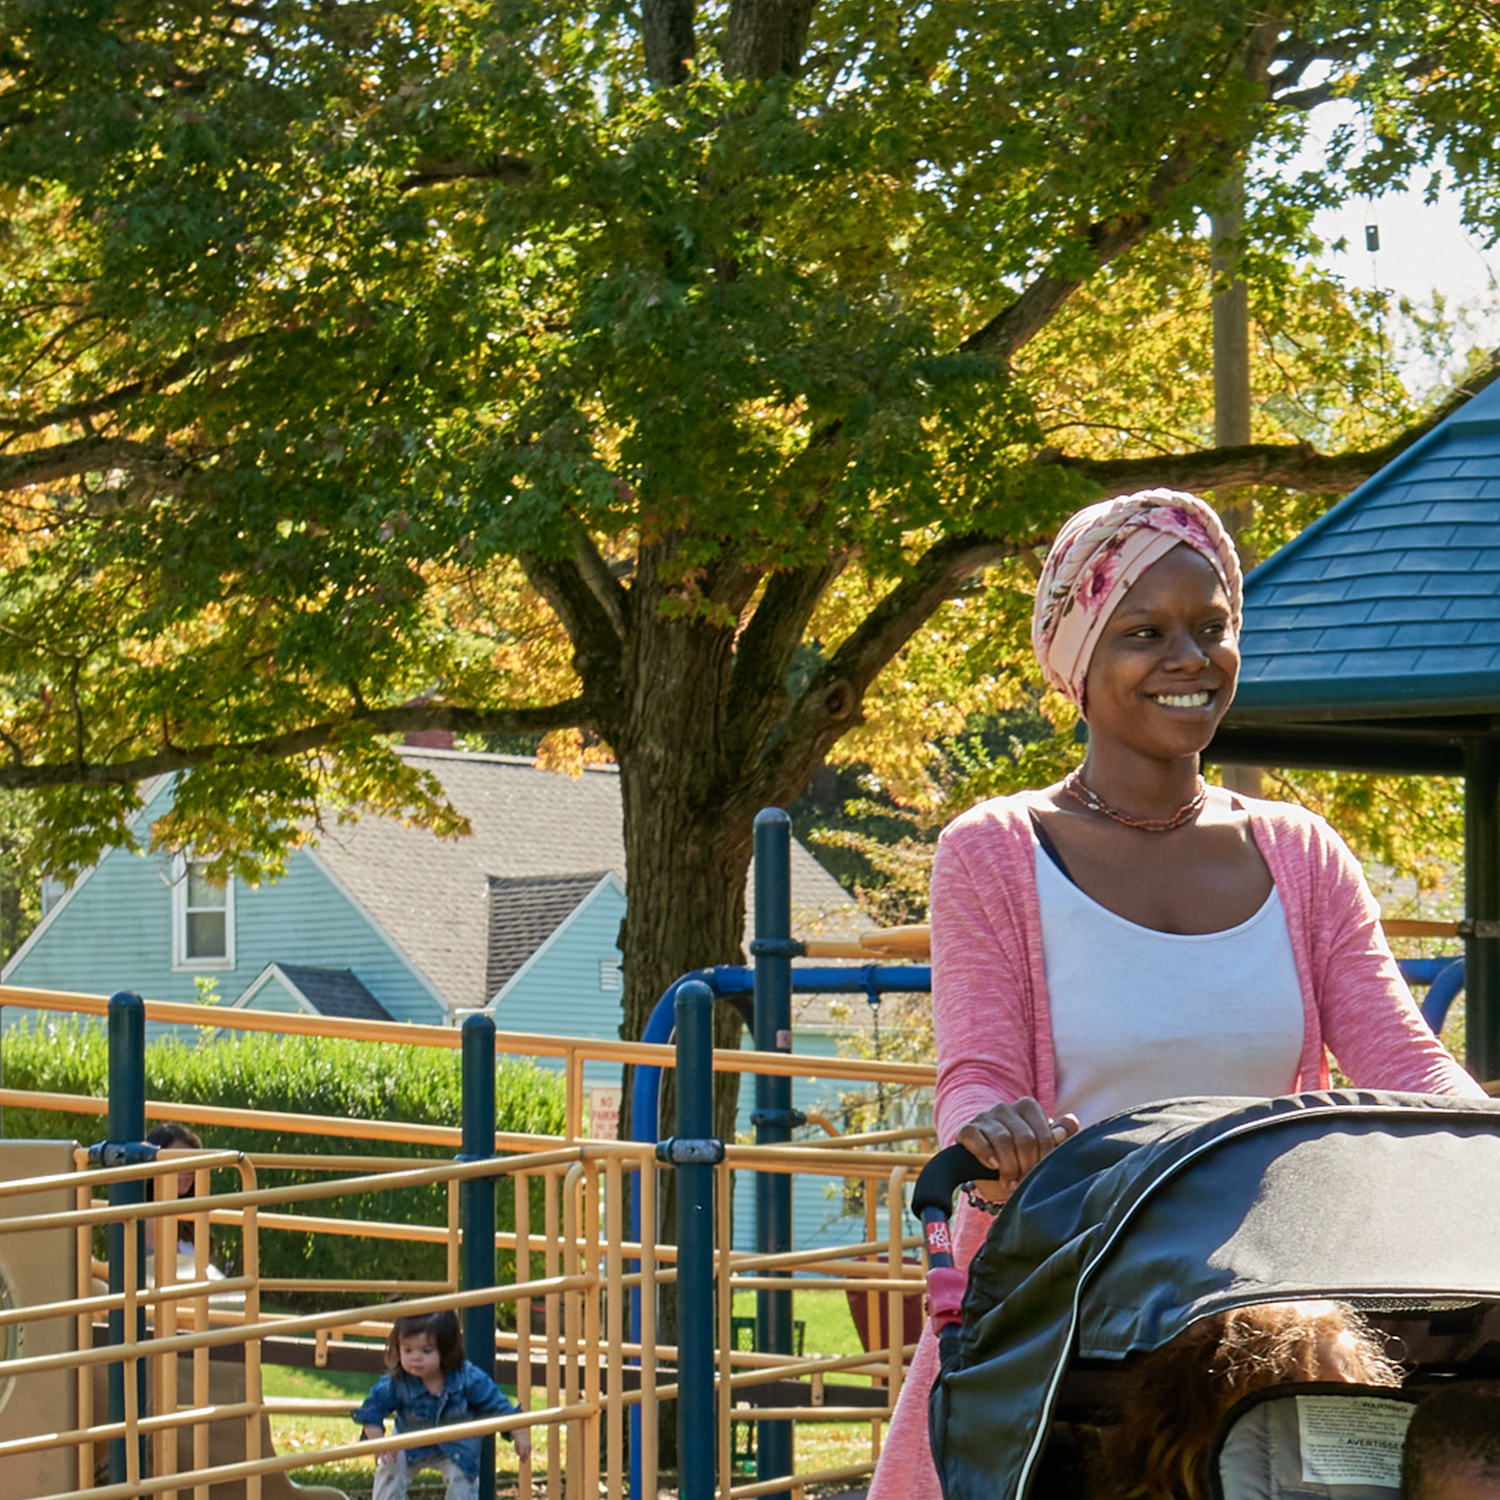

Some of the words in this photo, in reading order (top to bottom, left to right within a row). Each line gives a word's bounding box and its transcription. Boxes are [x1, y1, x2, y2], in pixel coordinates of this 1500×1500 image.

[600, 1096, 613, 1108] NO
[591, 1110, 618, 1121] PARKIN
[1361, 1401, 1408, 1413] WARNING
[1346, 1438, 1404, 1450] AVERTISSE
